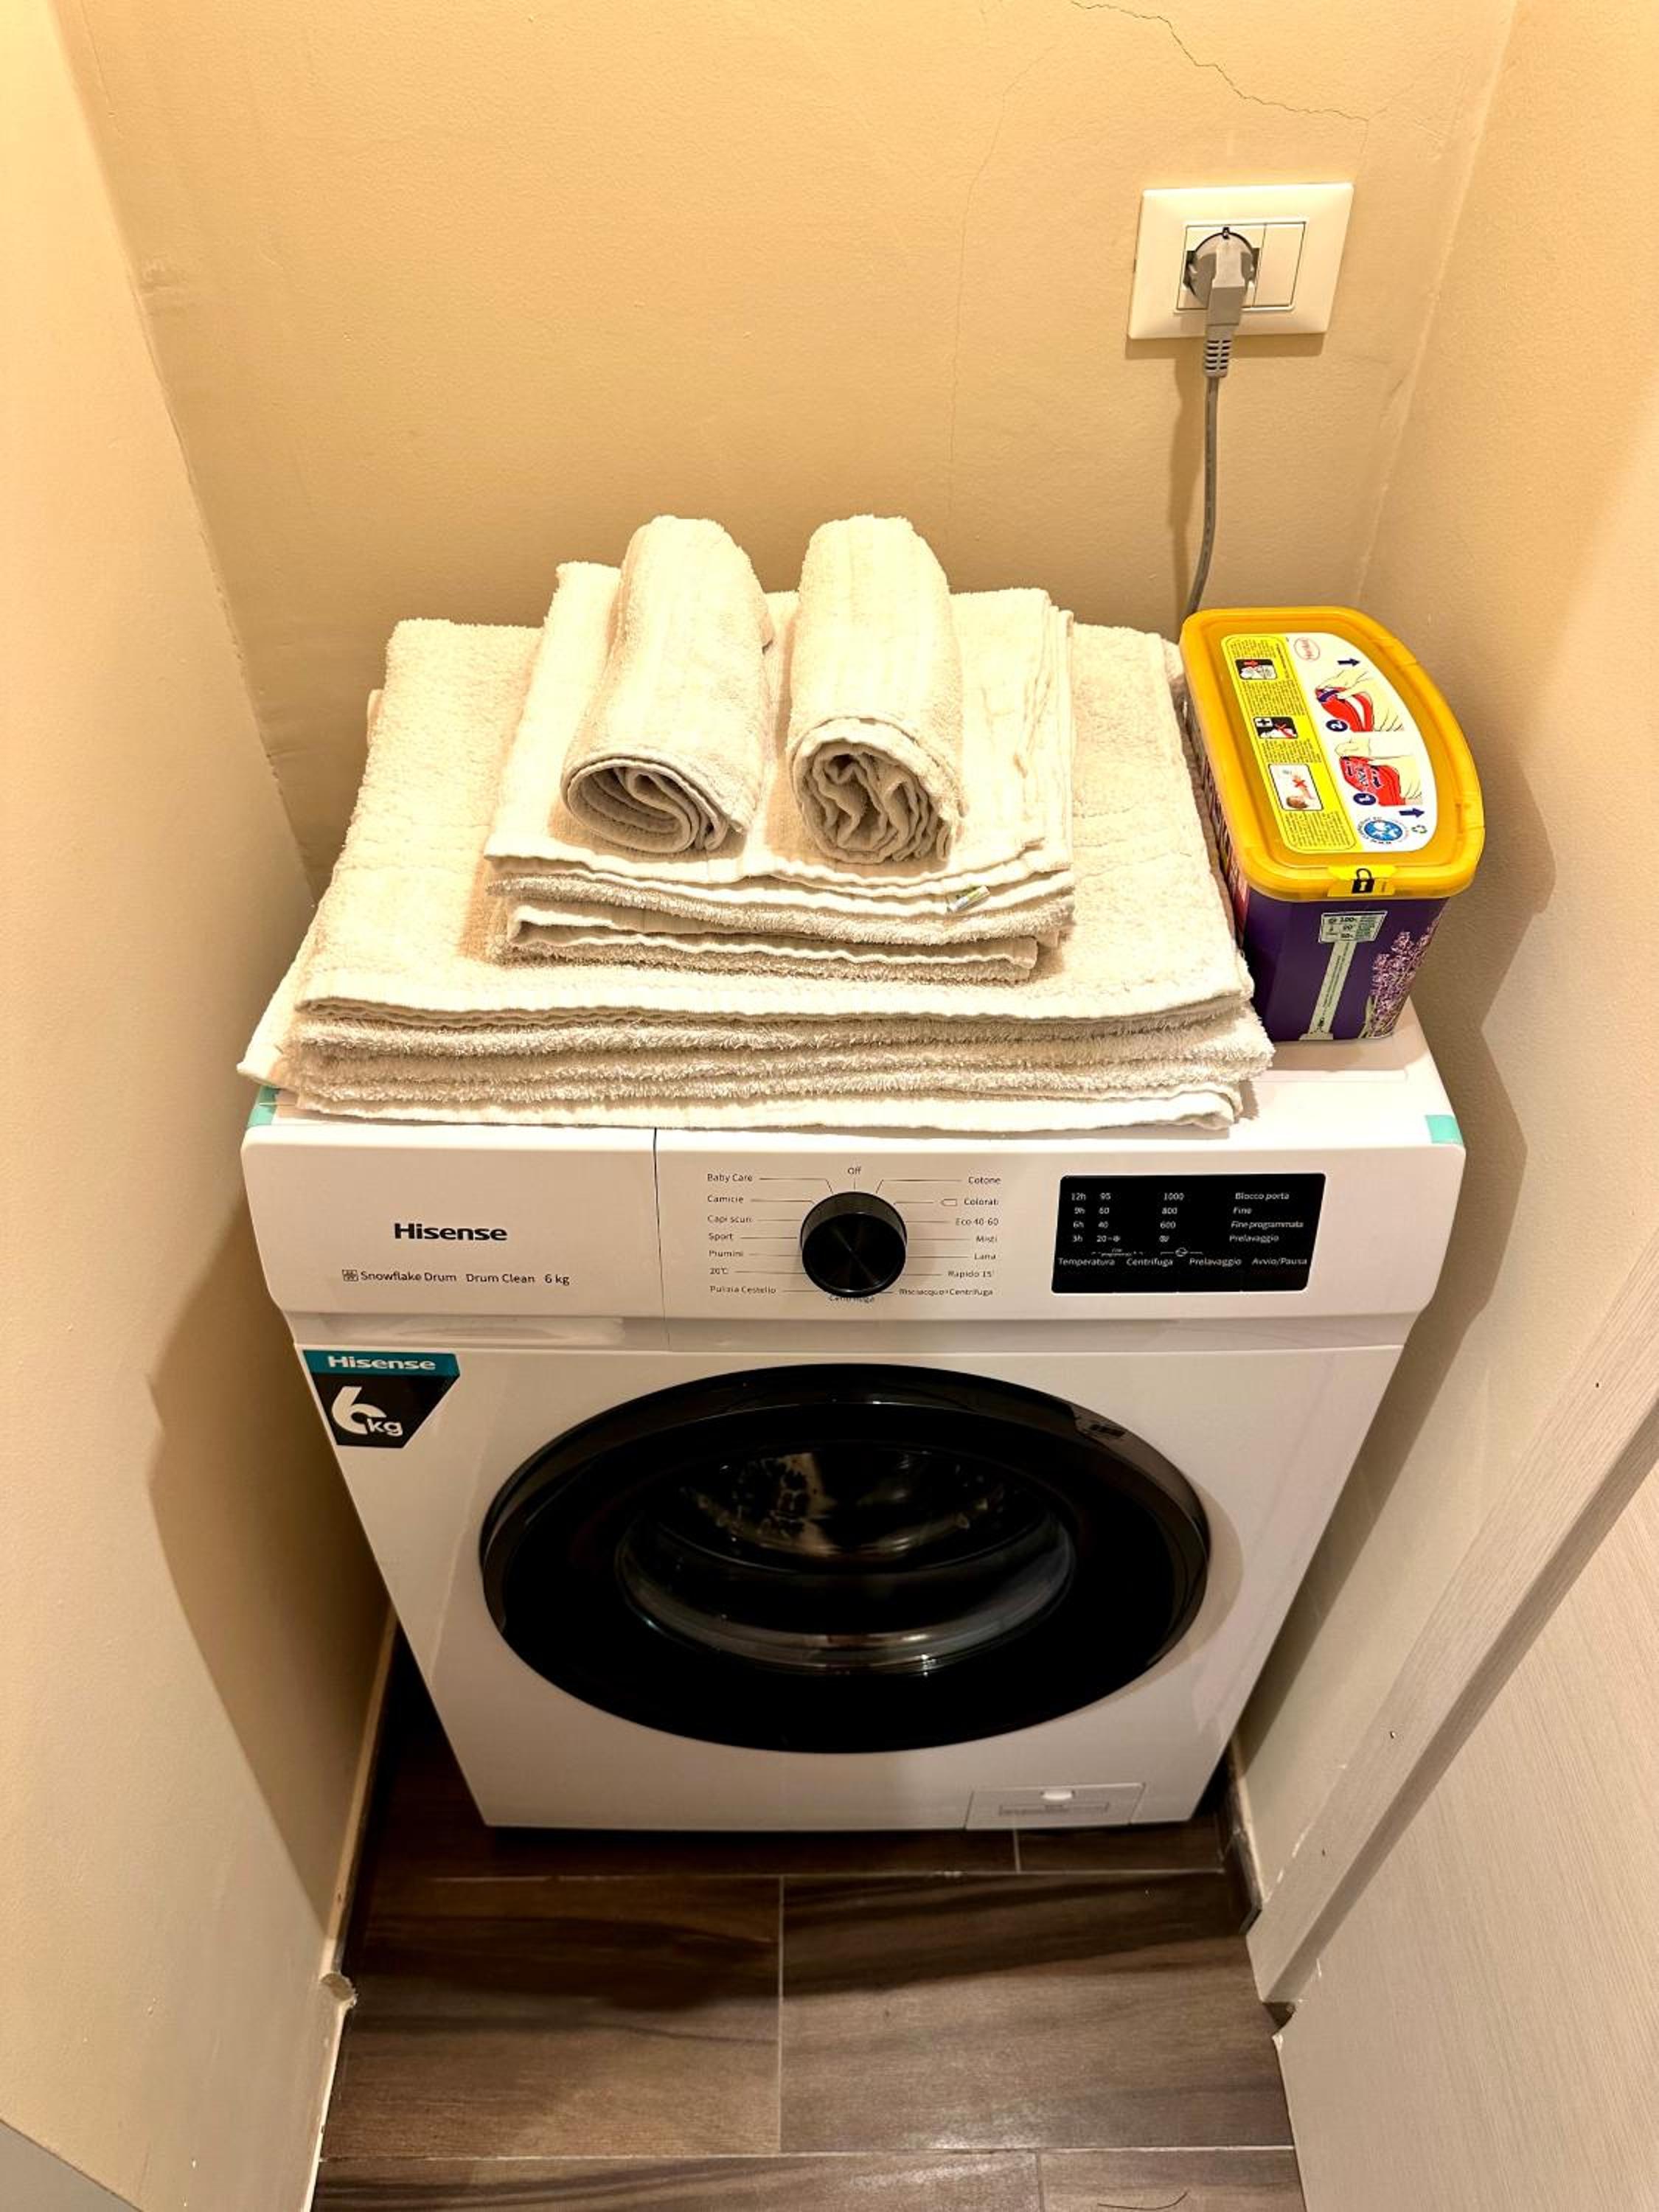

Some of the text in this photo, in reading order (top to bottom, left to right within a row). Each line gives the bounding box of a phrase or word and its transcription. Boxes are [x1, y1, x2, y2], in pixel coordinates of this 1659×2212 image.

[847, 1166, 861, 1175] Off
[707, 1173, 753, 1183] Baby Care
[968, 1176, 1001, 1185] Cotone
[1071, 1192, 1086, 1201] 12h
[1164, 1192, 1184, 1201] 1000
[1265, 1192, 1290, 1201] porta
[1233, 1206, 1253, 1214] Fine
[956, 1218, 972, 1226] Eco
[1160, 1221, 1176, 1229] 600
[1231, 1220, 1304, 1230] Fine programmata
[394, 1222, 508, 1241] Hisense
[709, 1233, 733, 1241] Sport
[1229, 1234, 1279, 1244] Prelavaggio
[1058, 1257, 1116, 1267] Temperatura
[1126, 1257, 1173, 1267] Centrifuga
[1189, 1256, 1242, 1267] Prelavaggio
[1252, 1257, 1307, 1266] Avvio/Pausa
[360, 1270, 457, 1282] Snowflake Drum
[466, 1273, 536, 1284] Drum Clean
[948, 1270, 980, 1279] Rapido
[544, 1274, 571, 1287] 6 kg
[741, 1285, 777, 1294] Cestello
[327, 1356, 437, 1370] Hisense
